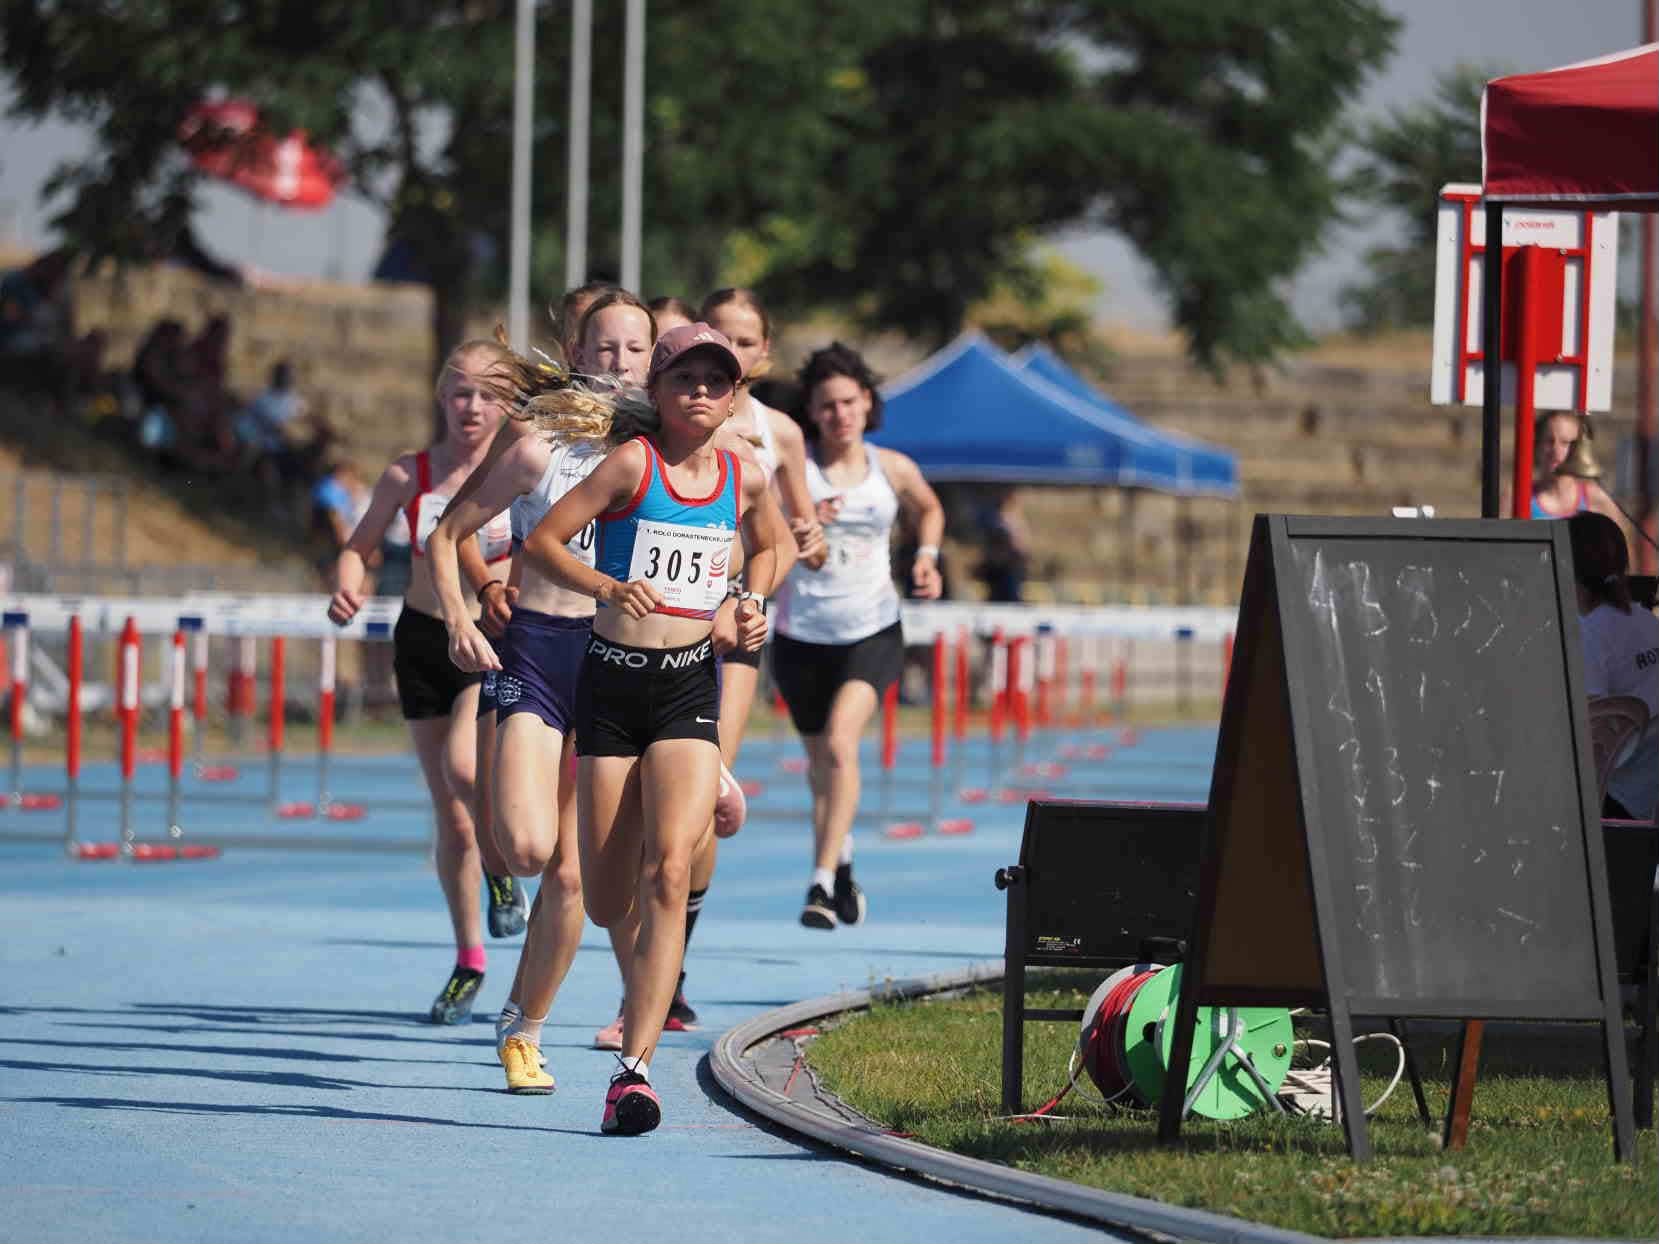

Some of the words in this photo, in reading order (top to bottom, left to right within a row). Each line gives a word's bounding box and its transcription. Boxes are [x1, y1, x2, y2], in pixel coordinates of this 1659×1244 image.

[644, 546, 703, 584] 305
[588, 640, 648, 669] PRO
[660, 639, 712, 670] NIKE
